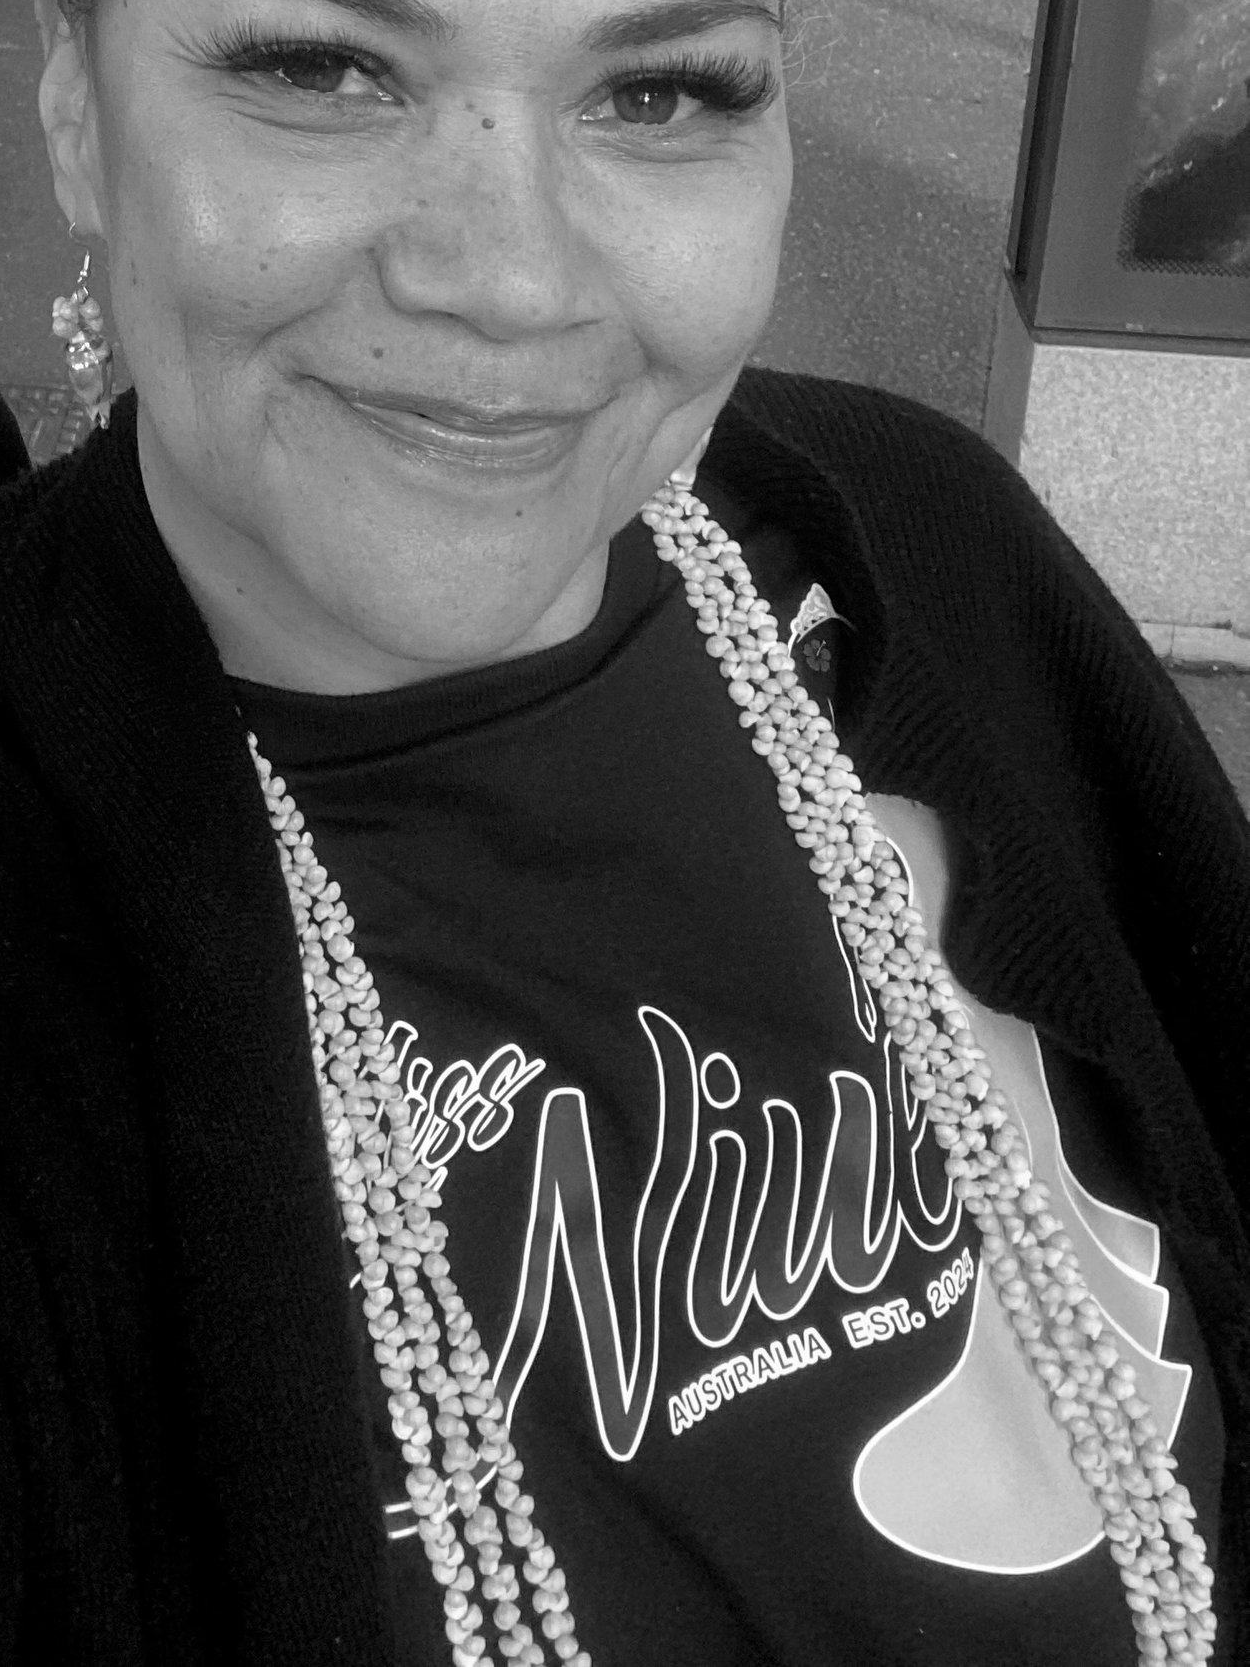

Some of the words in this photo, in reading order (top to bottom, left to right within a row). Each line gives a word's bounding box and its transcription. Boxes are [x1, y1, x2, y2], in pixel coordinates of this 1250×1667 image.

[668, 1327, 832, 1436] AUSTRALIA
[842, 1297, 926, 1349] EST.
[926, 1246, 975, 1319] 2024
